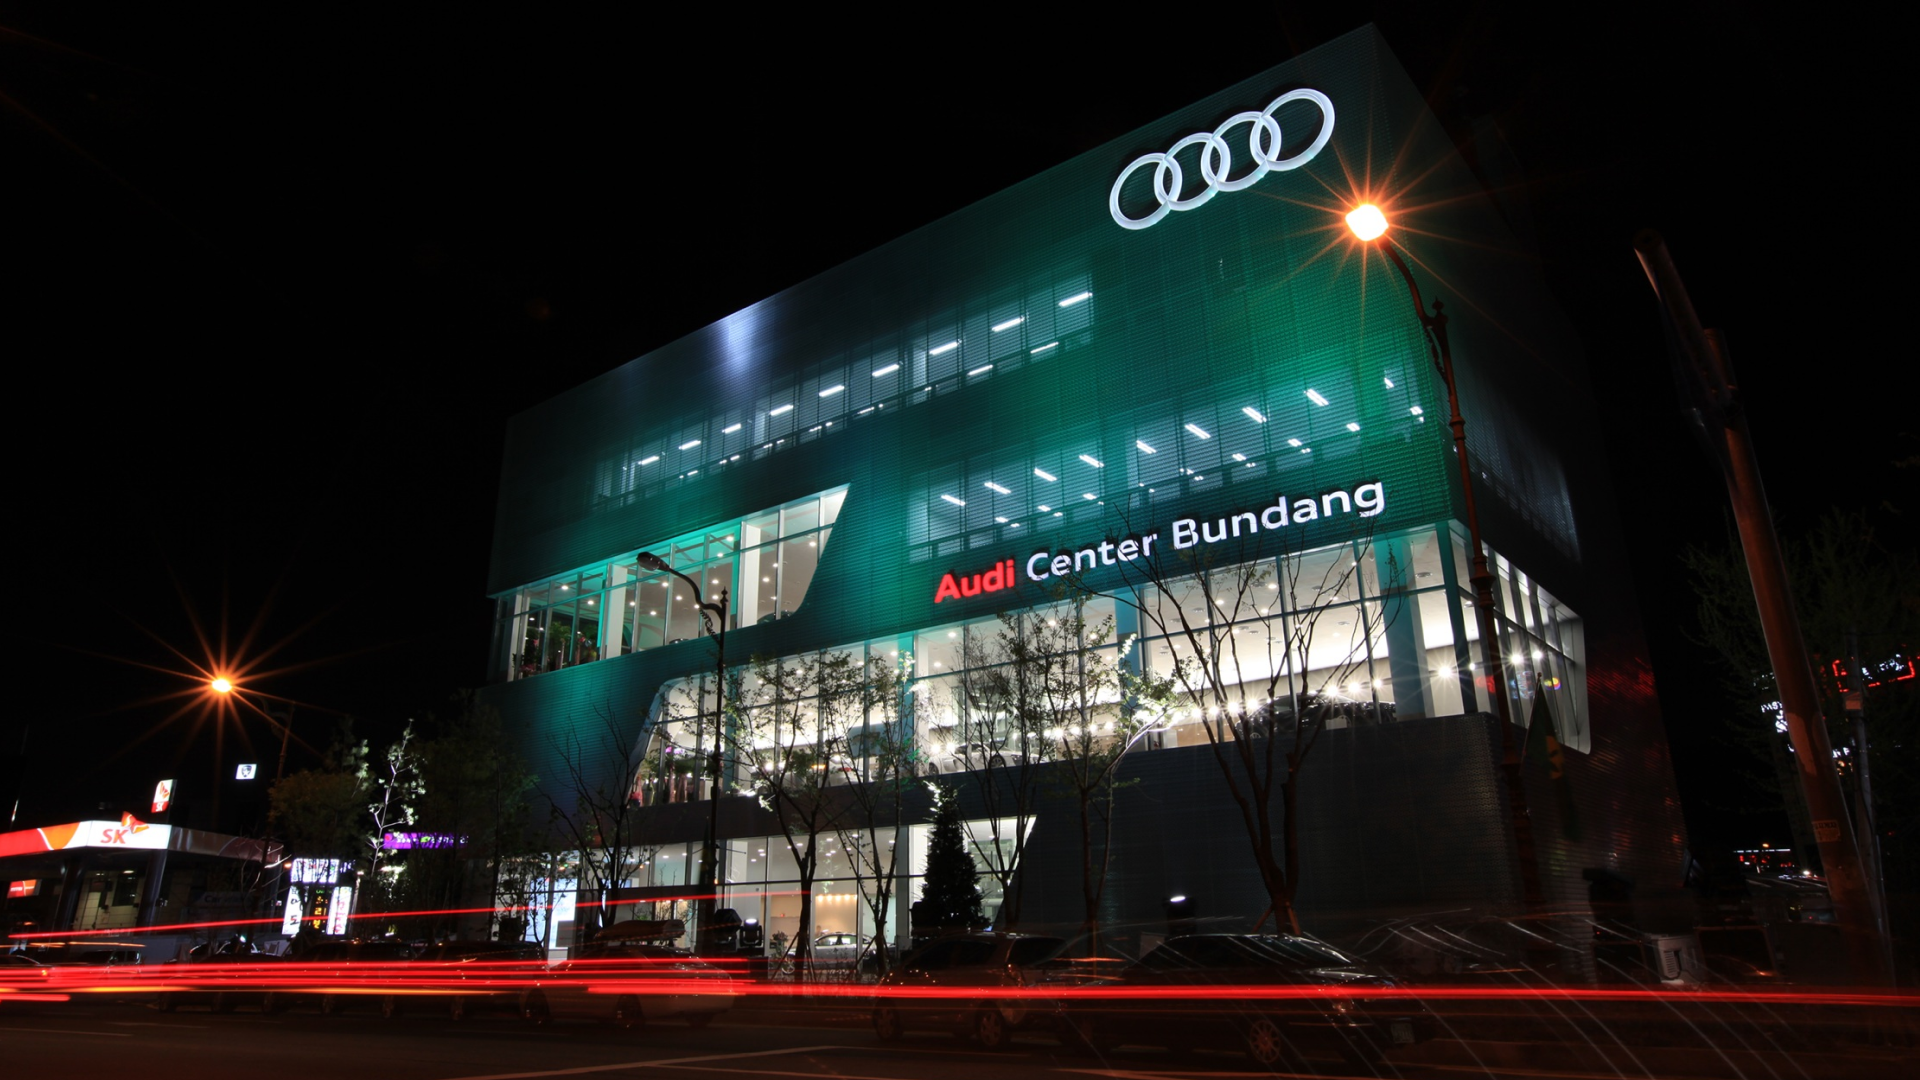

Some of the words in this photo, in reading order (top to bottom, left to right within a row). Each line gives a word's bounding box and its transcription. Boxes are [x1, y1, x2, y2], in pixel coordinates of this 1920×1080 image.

[934, 559, 1016, 604] Audi
[1026, 532, 1159, 582] Center
[1171, 480, 1386, 551] Bundang
[155, 802, 164, 812] SK
[100, 828, 129, 844] SK
